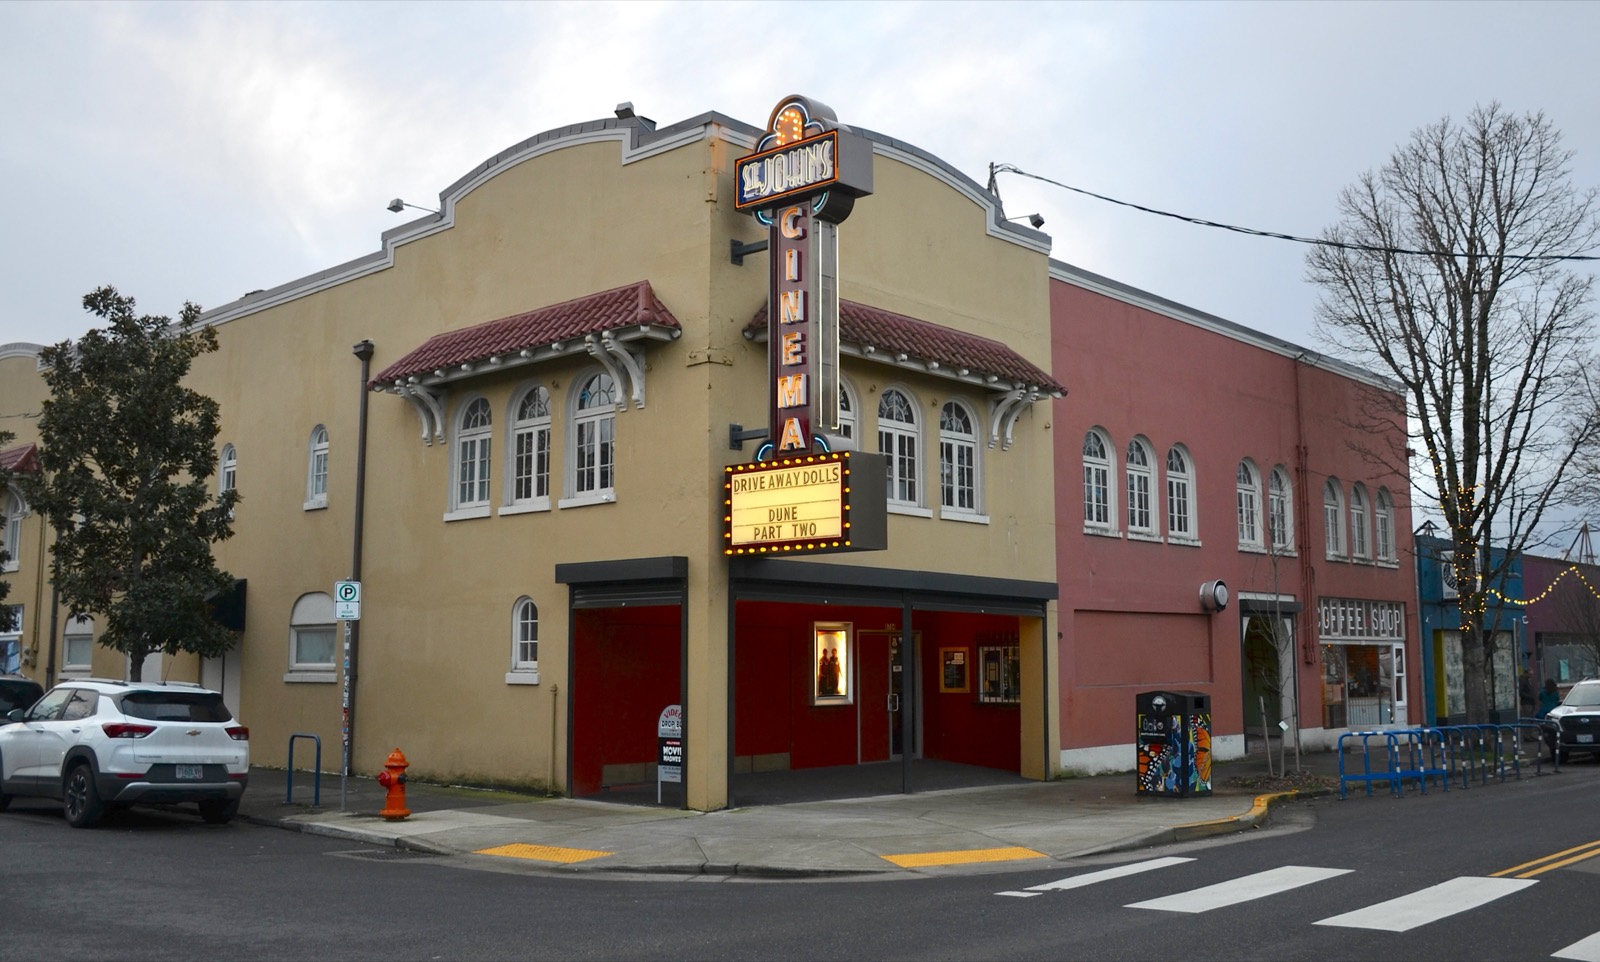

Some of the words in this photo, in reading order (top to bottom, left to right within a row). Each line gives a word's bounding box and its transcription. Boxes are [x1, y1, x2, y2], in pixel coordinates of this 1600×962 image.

[760, 140, 834, 197] JOHNS
[779, 206, 808, 451] CINEMA
[733, 475, 766, 493] DRIVE
[768, 471, 801, 489] AWAY
[803, 467, 839, 485] DOLLS
[768, 506, 798, 523] DUNE
[754, 525, 782, 541] PART
[791, 522, 817, 538] TWO
[344, 588, 353, 598] P
[1372, 608, 1401, 631] SHOP
